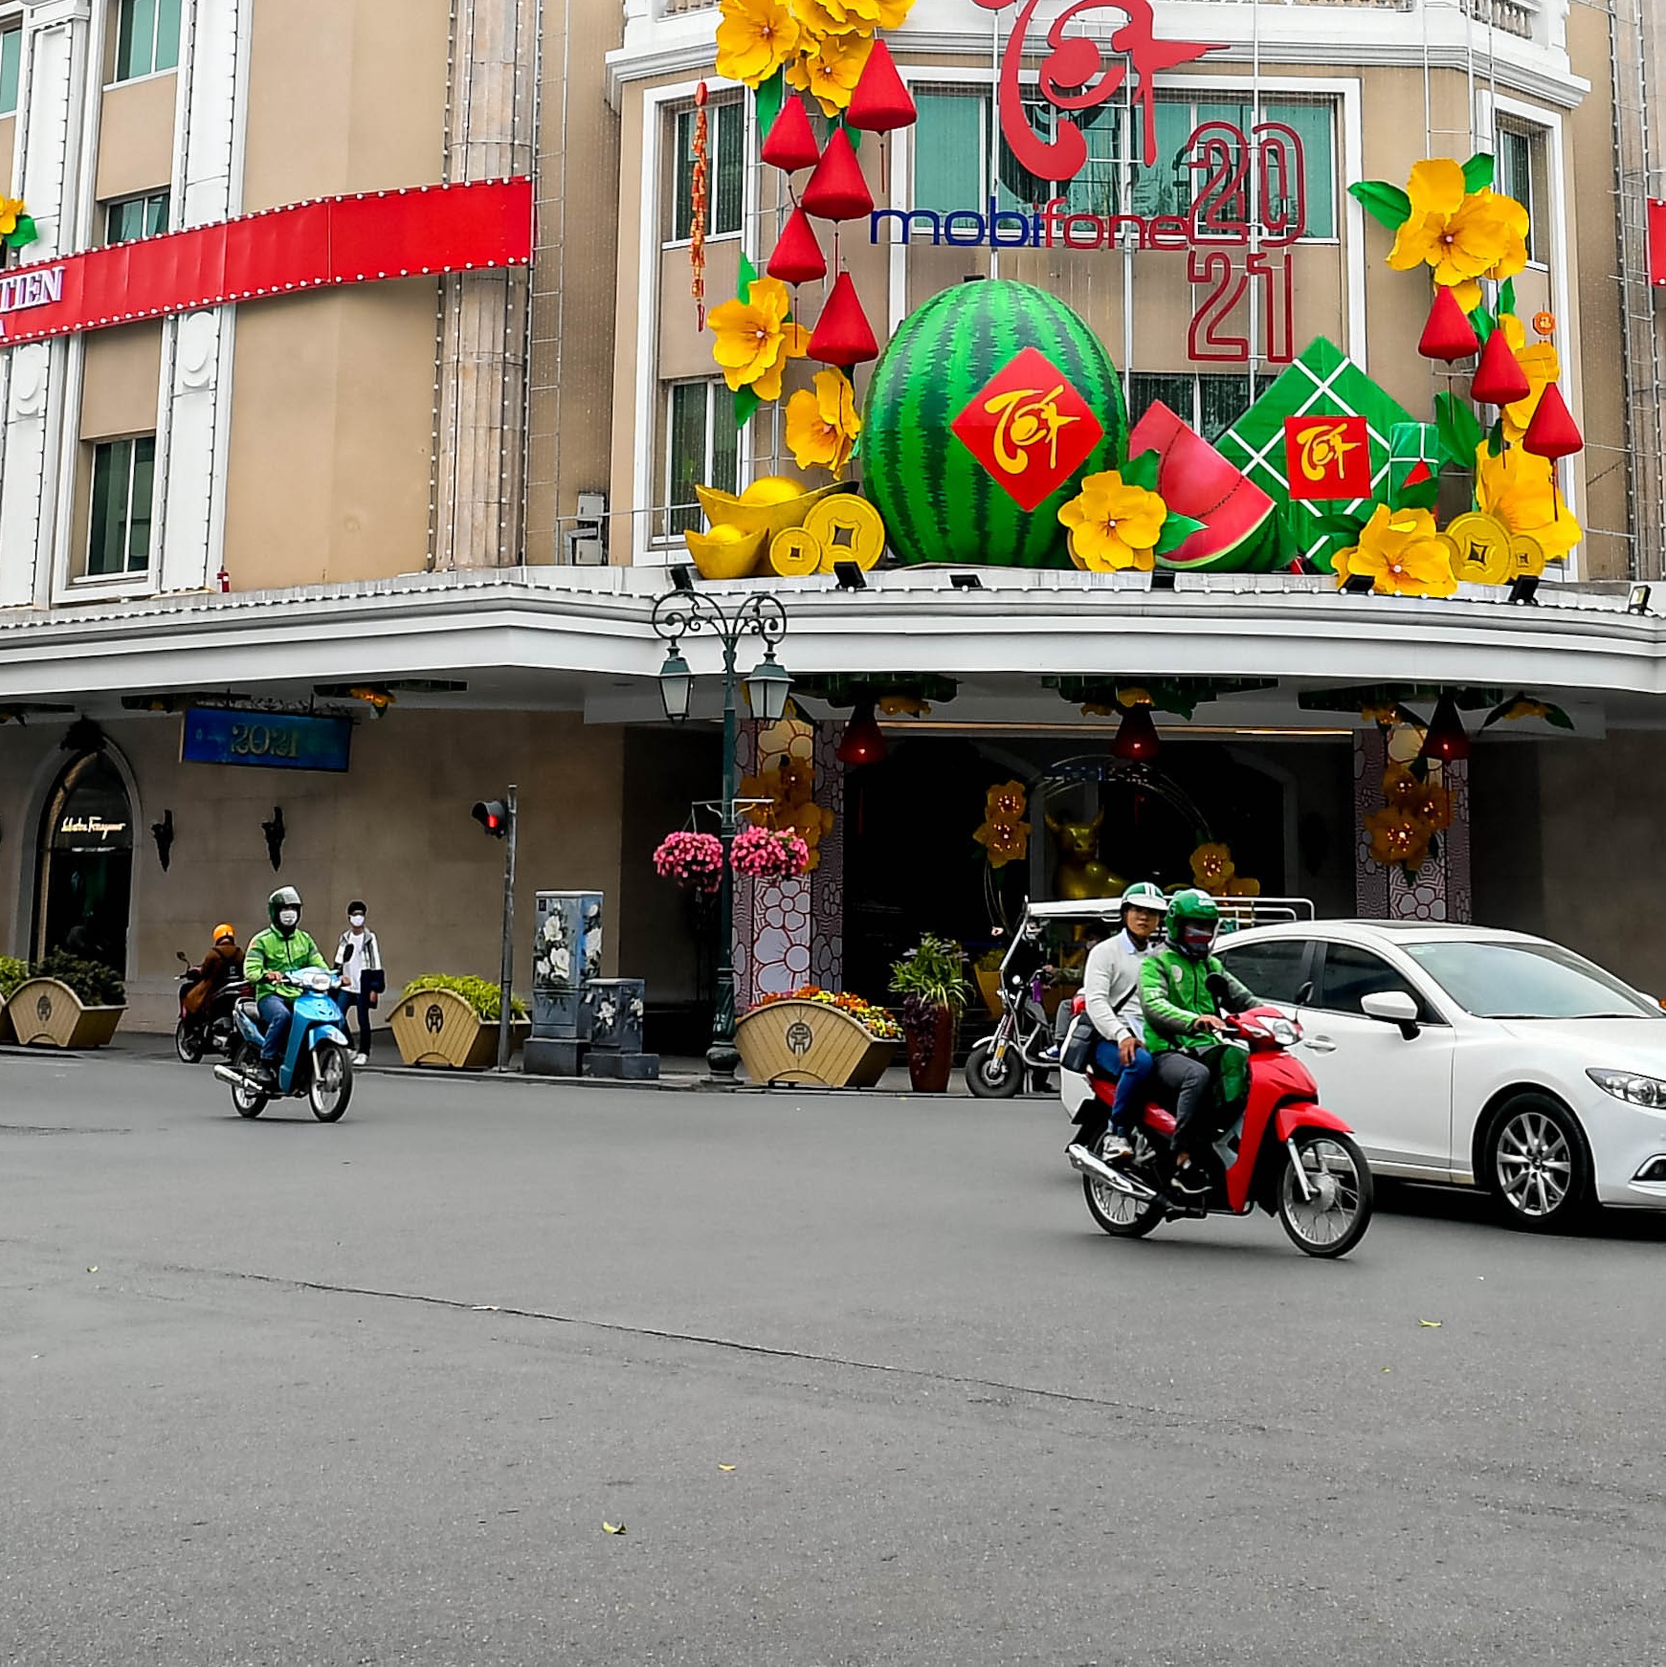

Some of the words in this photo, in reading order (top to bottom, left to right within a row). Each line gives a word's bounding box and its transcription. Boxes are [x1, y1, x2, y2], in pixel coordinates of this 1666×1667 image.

[870, 197, 1190, 250] mobifone
[1187, 120, 1307, 248] 20
[1187, 251, 1295, 363] 21
